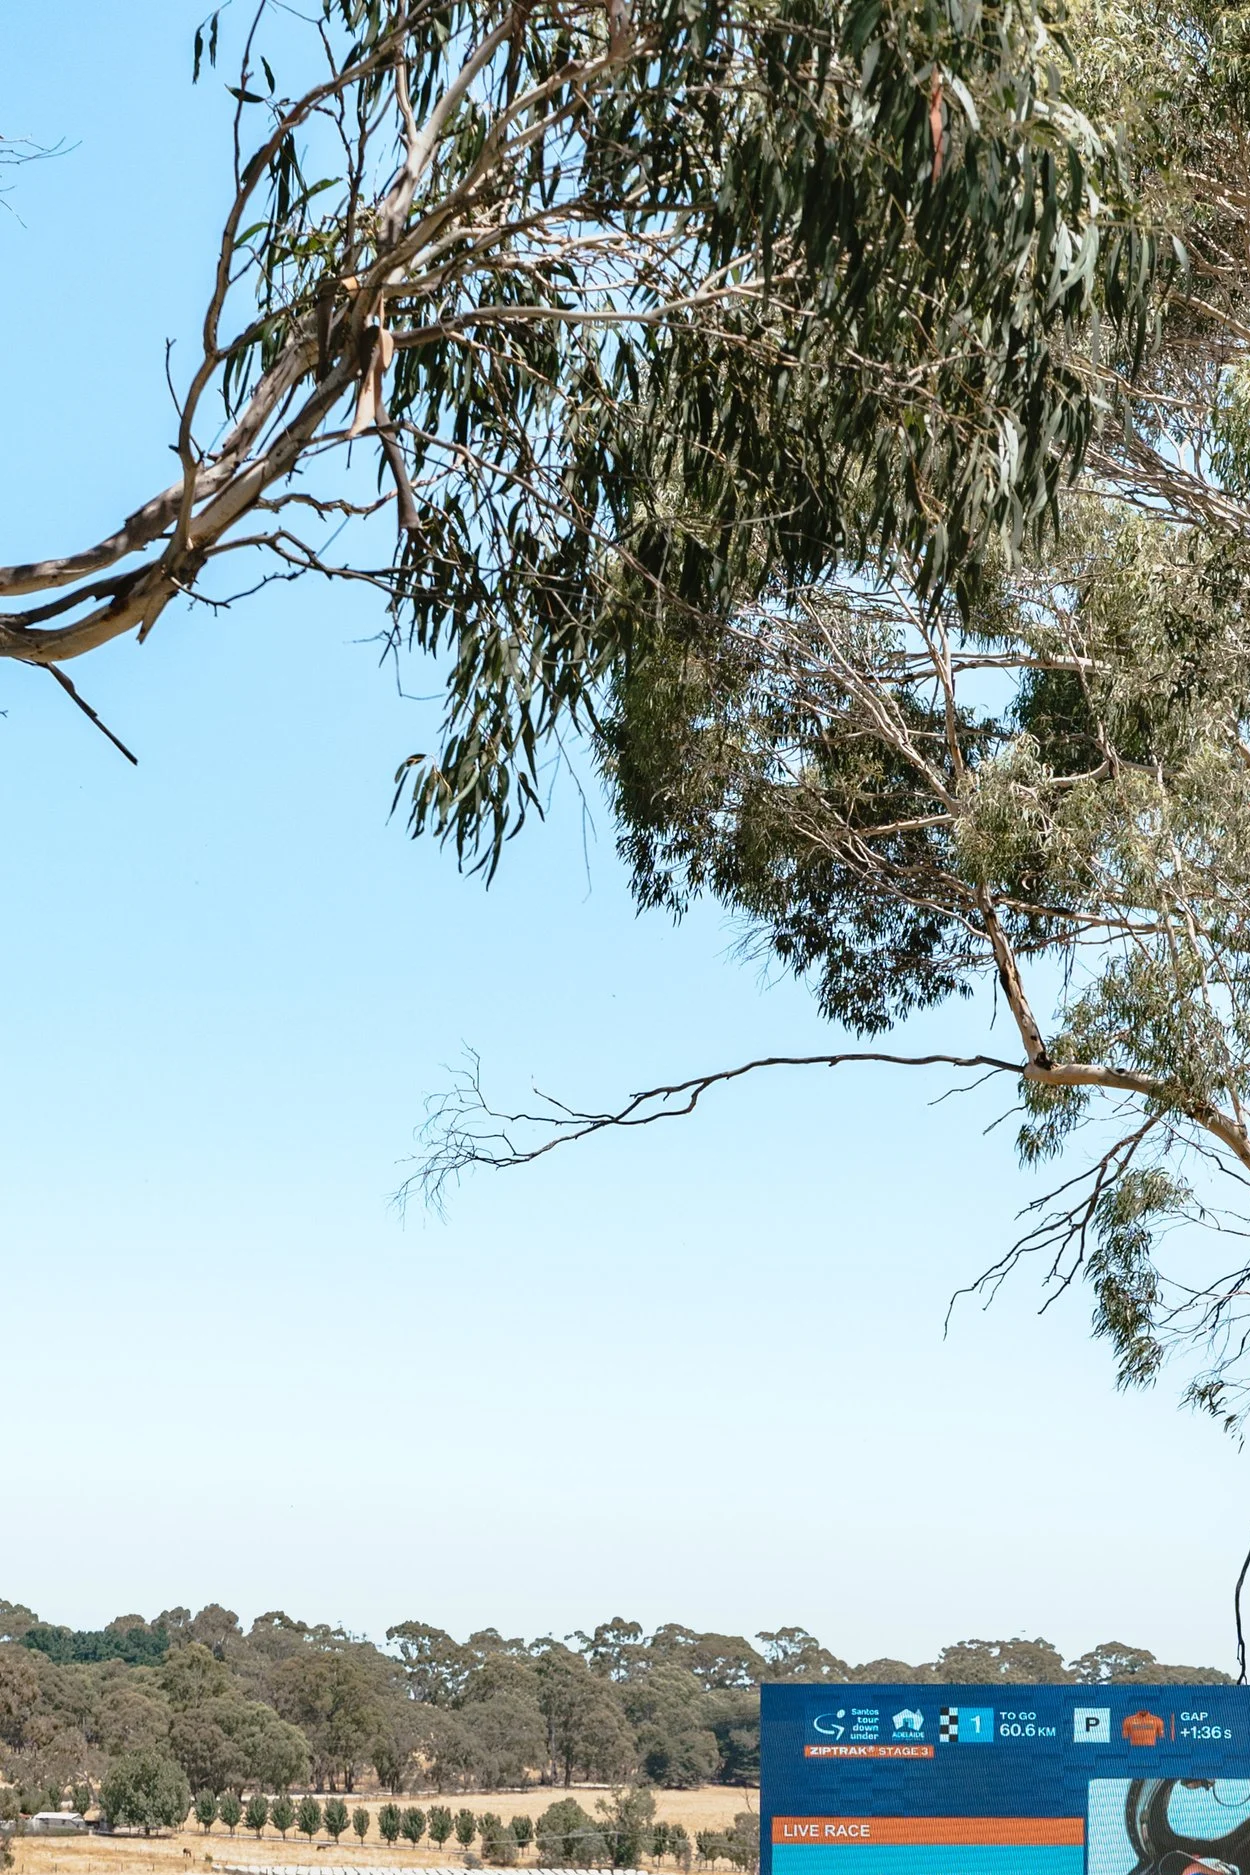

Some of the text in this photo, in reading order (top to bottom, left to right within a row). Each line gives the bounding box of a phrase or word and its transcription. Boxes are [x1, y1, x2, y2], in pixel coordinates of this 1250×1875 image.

[851, 1708, 879, 1716] Santos
[1000, 1712, 1037, 1720] TO GO
[1180, 1712, 1208, 1721] GAP
[857, 1716, 879, 1724] tour
[970, 1715, 981, 1734] 1
[1085, 1717, 1100, 1732] P
[853, 1724, 879, 1732] down
[1000, 1723, 1056, 1737] 60.6 KM
[1180, 1726, 1221, 1739] +1:36
[879, 1747, 919, 1756] STAGE
[921, 1747, 929, 1756] 3
[784, 1824, 870, 1837] LIVE RACE
